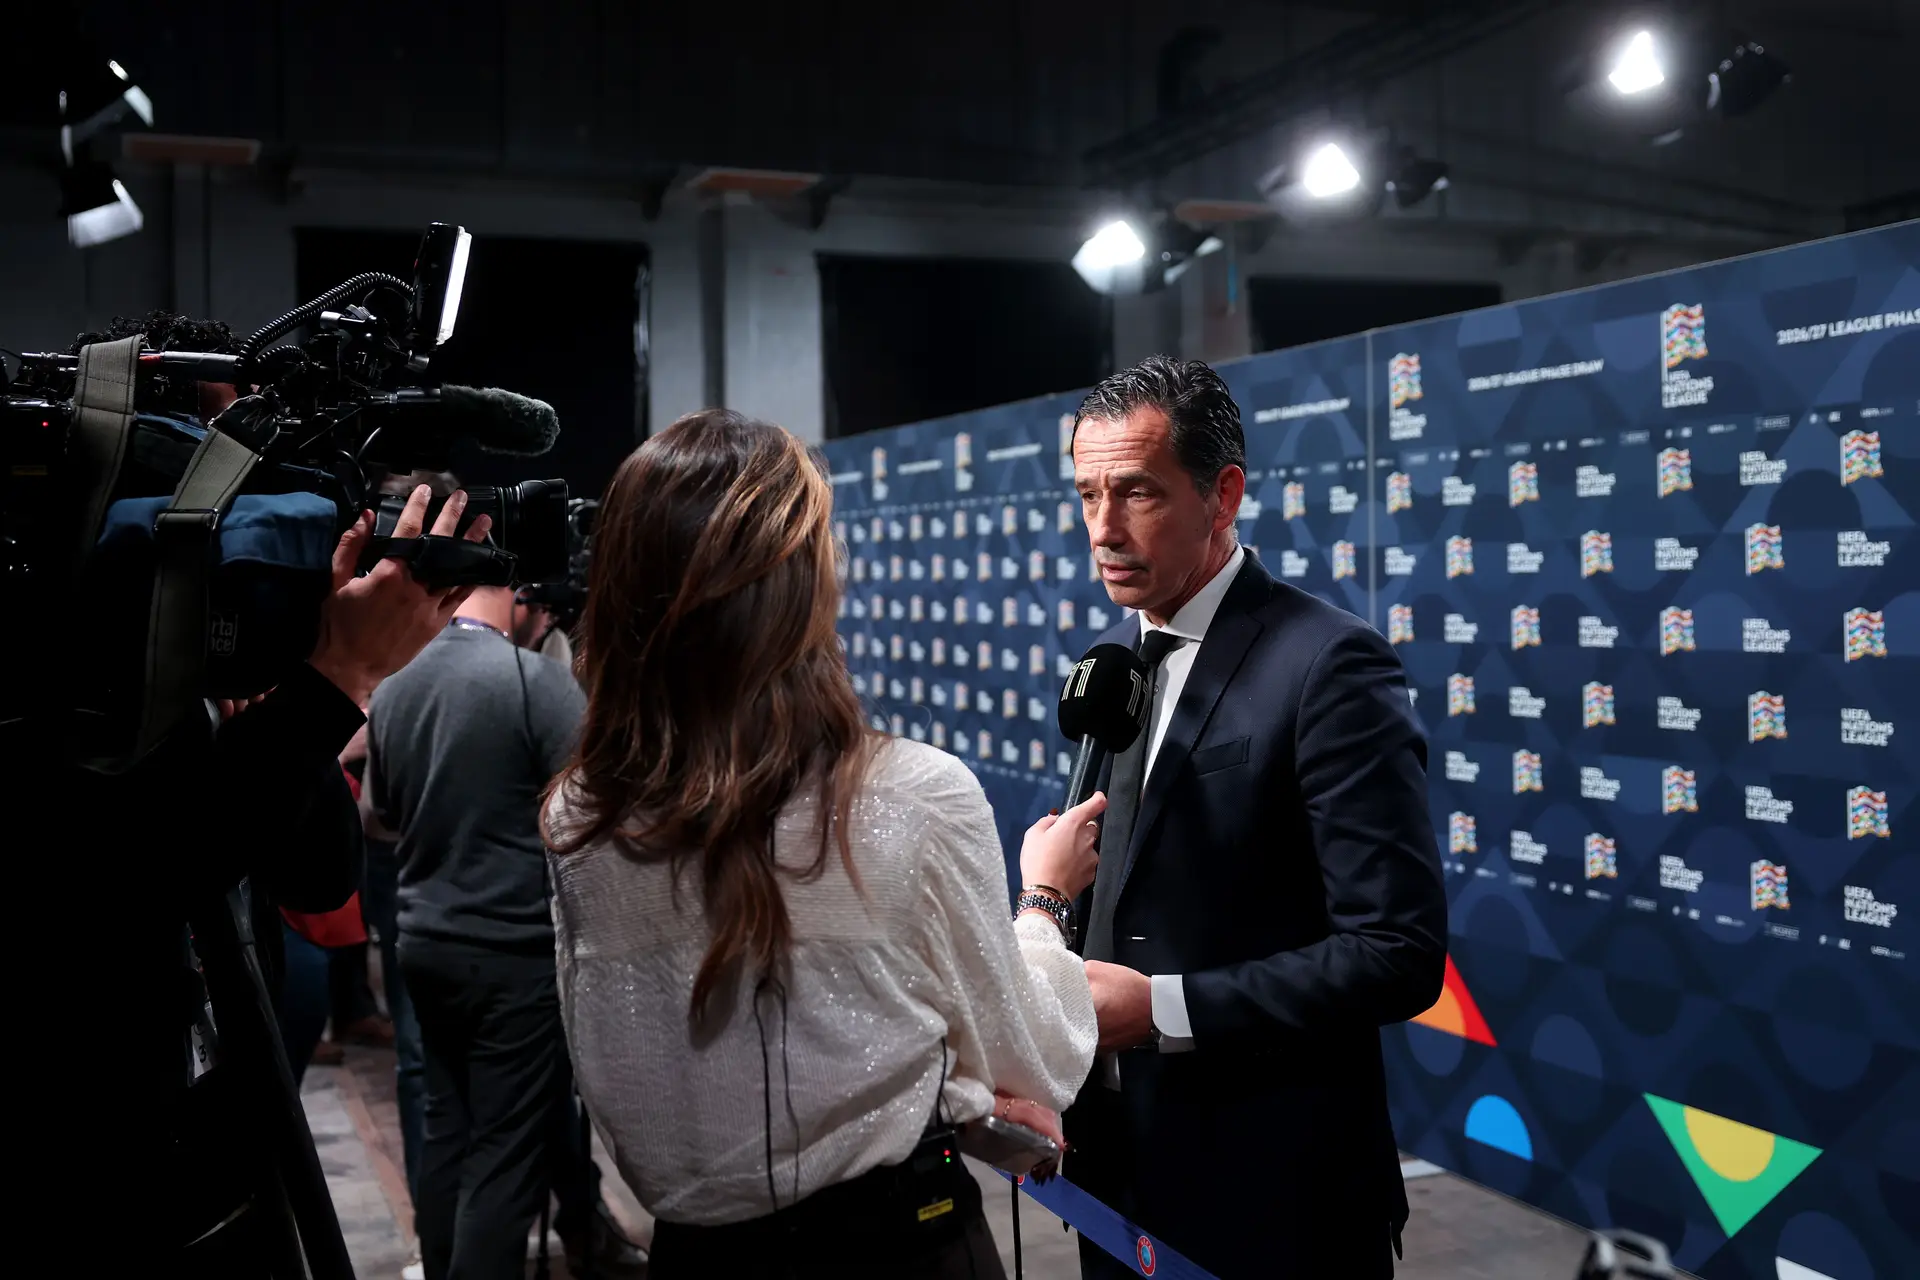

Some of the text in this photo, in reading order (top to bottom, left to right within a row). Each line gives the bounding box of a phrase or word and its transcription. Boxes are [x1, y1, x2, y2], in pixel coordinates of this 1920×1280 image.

[1828, 314, 1883, 337] LEAGUE
[1669, 370, 1691, 381] UEFA
[1662, 376, 1713, 393] NATIONS
[1662, 390, 1707, 408] LEAGUE
[1739, 451, 1767, 462] UEFA
[1740, 459, 1787, 474] NATIONS
[1740, 471, 1781, 485] LEAGUE
[1837, 531, 1867, 542] UEFA
[1655, 547, 1698, 559] NATIONS
[1838, 541, 1890, 554] NATIONS
[1655, 558, 1693, 570] LEAGUE
[1838, 554, 1884, 566] LEAGUE
[211, 616, 233, 636] rta
[1742, 619, 1770, 629] UEFA
[1743, 629, 1790, 642] NATIONS
[1743, 640, 1785, 653] LEAGUE
[1657, 696, 1683, 708] UEFA
[1657, 707, 1701, 721] NATIONS
[1841, 708, 1871, 720] UEFA
[1658, 717, 1696, 731] LEAGUE
[1841, 720, 1894, 735] NATIONS
[1841, 732, 1888, 746] LEAGUE
[1745, 785, 1773, 798] UEFA
[1746, 797, 1793, 813] NATIONS
[1746, 808, 1788, 823] LEAGUE
[1660, 866, 1703, 883] NATIONS
[1660, 876, 1698, 893] LEAGUE
[1844, 885, 1874, 900] UEFA
[1844, 897, 1897, 917] NATIONS
[1844, 907, 1891, 928] LEAGUE
